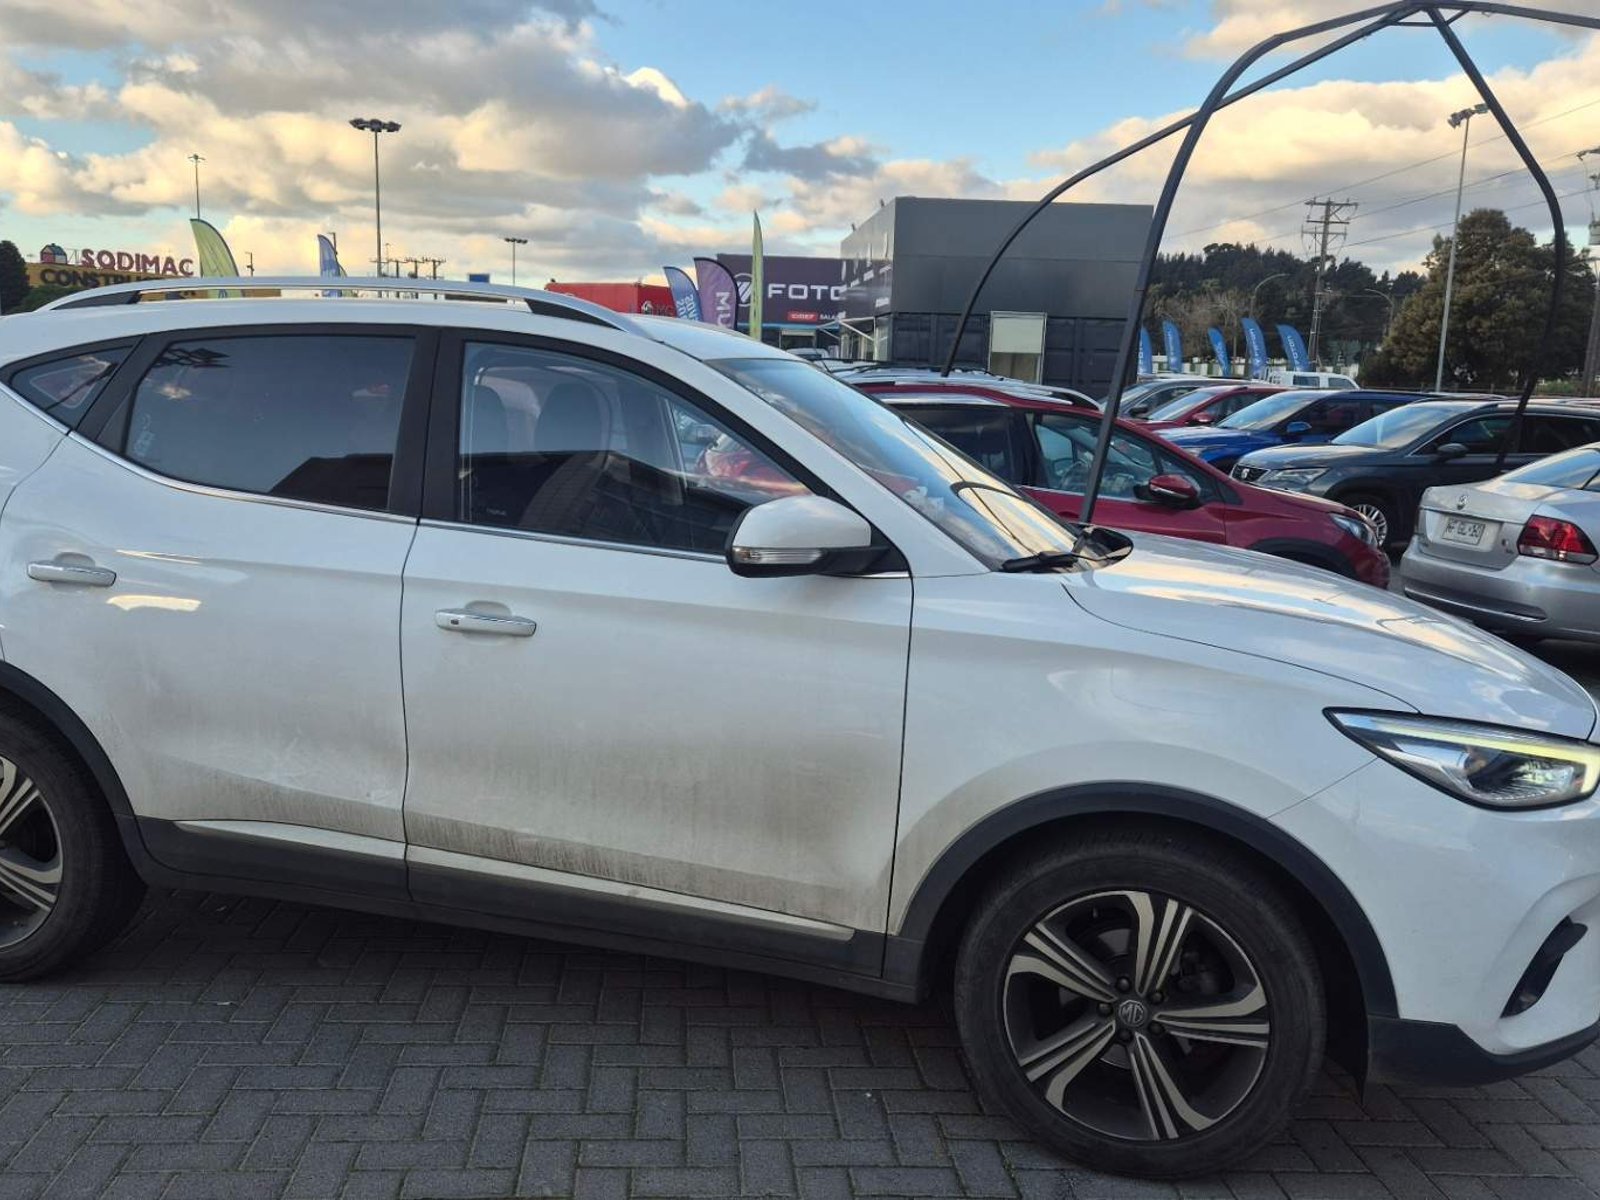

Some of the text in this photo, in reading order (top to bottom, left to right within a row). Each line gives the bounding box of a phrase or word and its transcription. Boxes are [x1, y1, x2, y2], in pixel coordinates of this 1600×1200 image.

[81, 248, 194, 277] SODIMAC
[40, 268, 160, 288] CONSTR
[1120, 1002, 1145, 1025] MG
